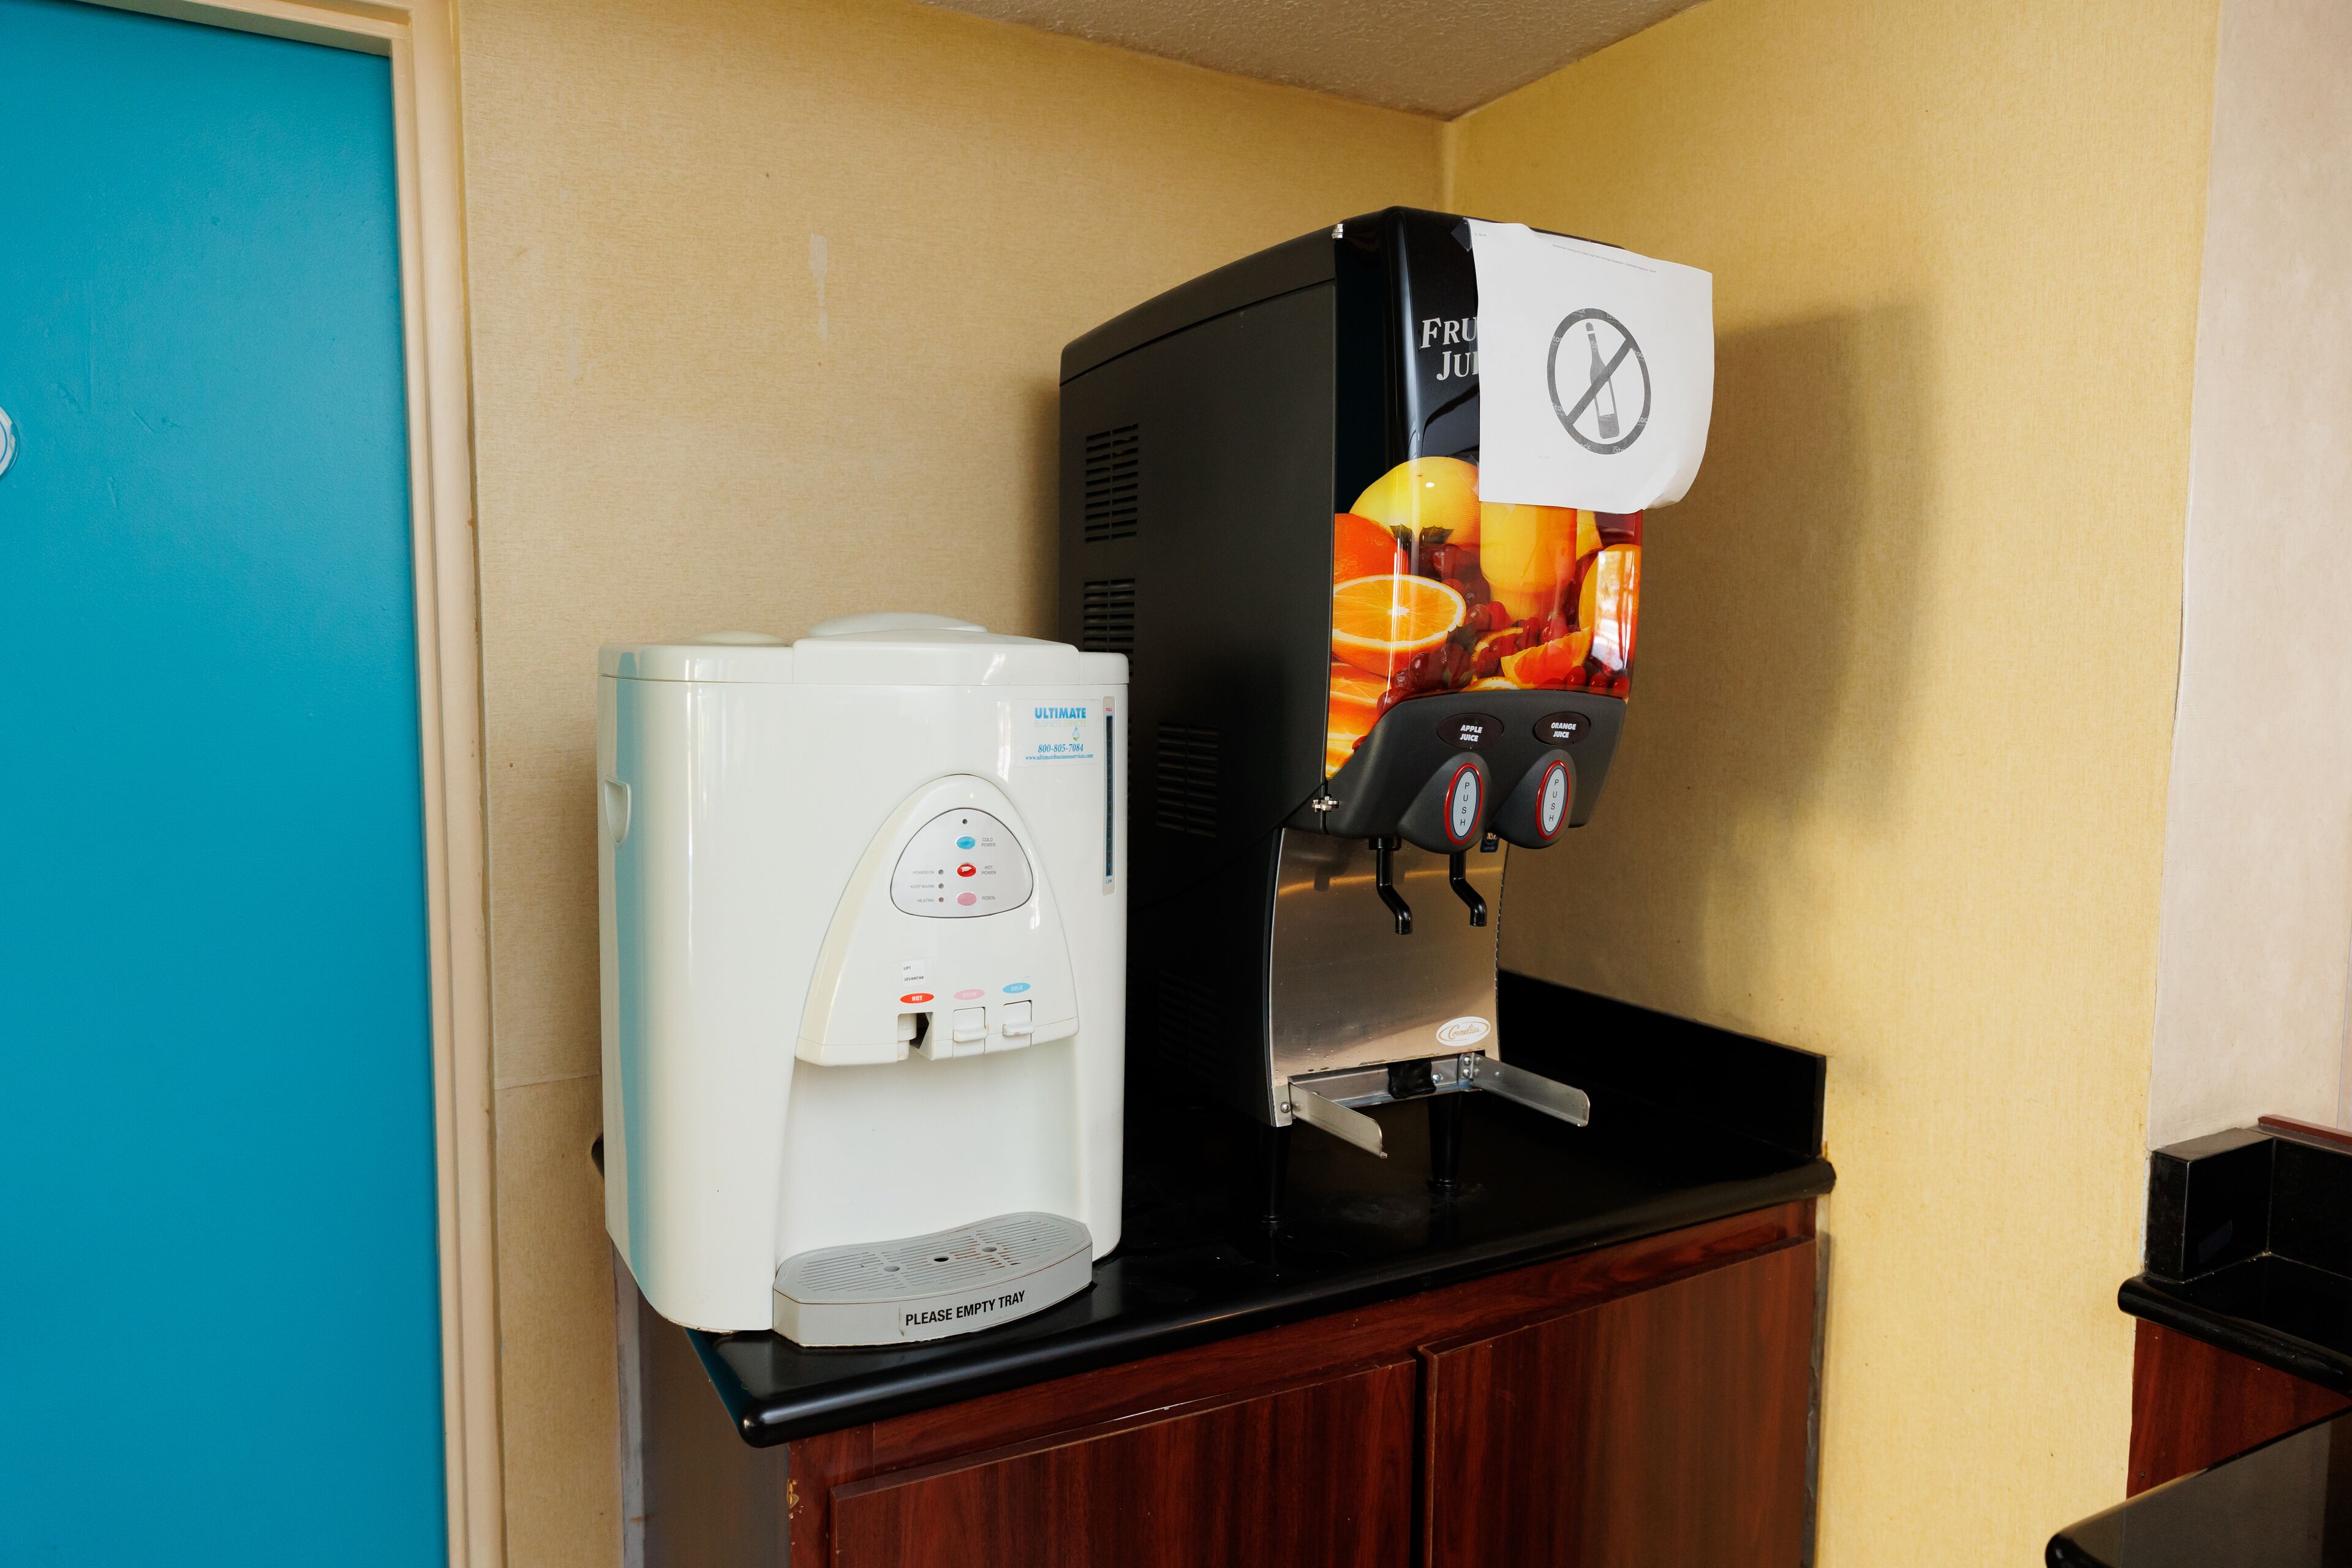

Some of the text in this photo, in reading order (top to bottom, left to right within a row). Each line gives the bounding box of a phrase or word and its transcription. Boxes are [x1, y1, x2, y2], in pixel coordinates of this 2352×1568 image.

[1420, 317, 1478, 349] FRU
[1436, 351, 1479, 380] JUI
[1035, 707, 1087, 719] ULTIMATE
[1460, 725, 1483, 734] APPLE
[1551, 722, 1577, 731] ORANGE
[1038, 743, 1084, 753] 800-805-7084
[1460, 782, 1470, 826] PUSH
[1548, 778, 1559, 821] PUSH
[1448, 1023, 1481, 1039] Cornelius
[905, 1290, 1025, 1326] PLEASE EMPTY TRAY
